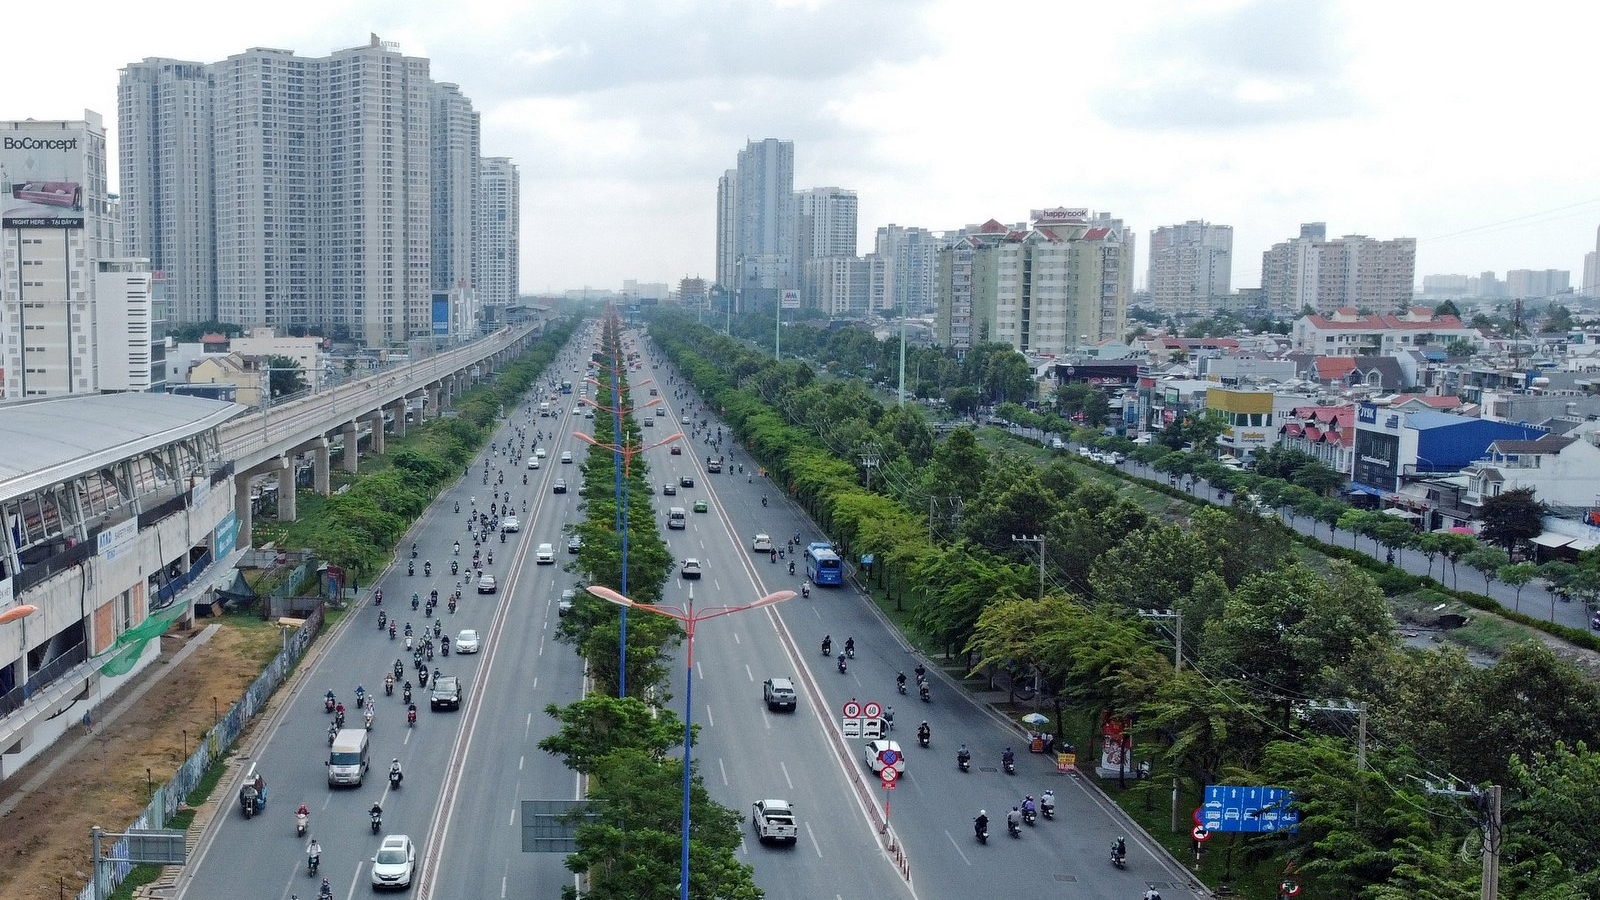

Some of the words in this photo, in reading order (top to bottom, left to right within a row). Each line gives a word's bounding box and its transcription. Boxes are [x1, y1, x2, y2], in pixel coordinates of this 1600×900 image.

[4, 137, 77, 152] BoConcept
[1043, 210, 1087, 219] happycook
[1360, 407, 1375, 419] JYSK
[849, 706, 856, 714] 80
[868, 706, 877, 714] 60
